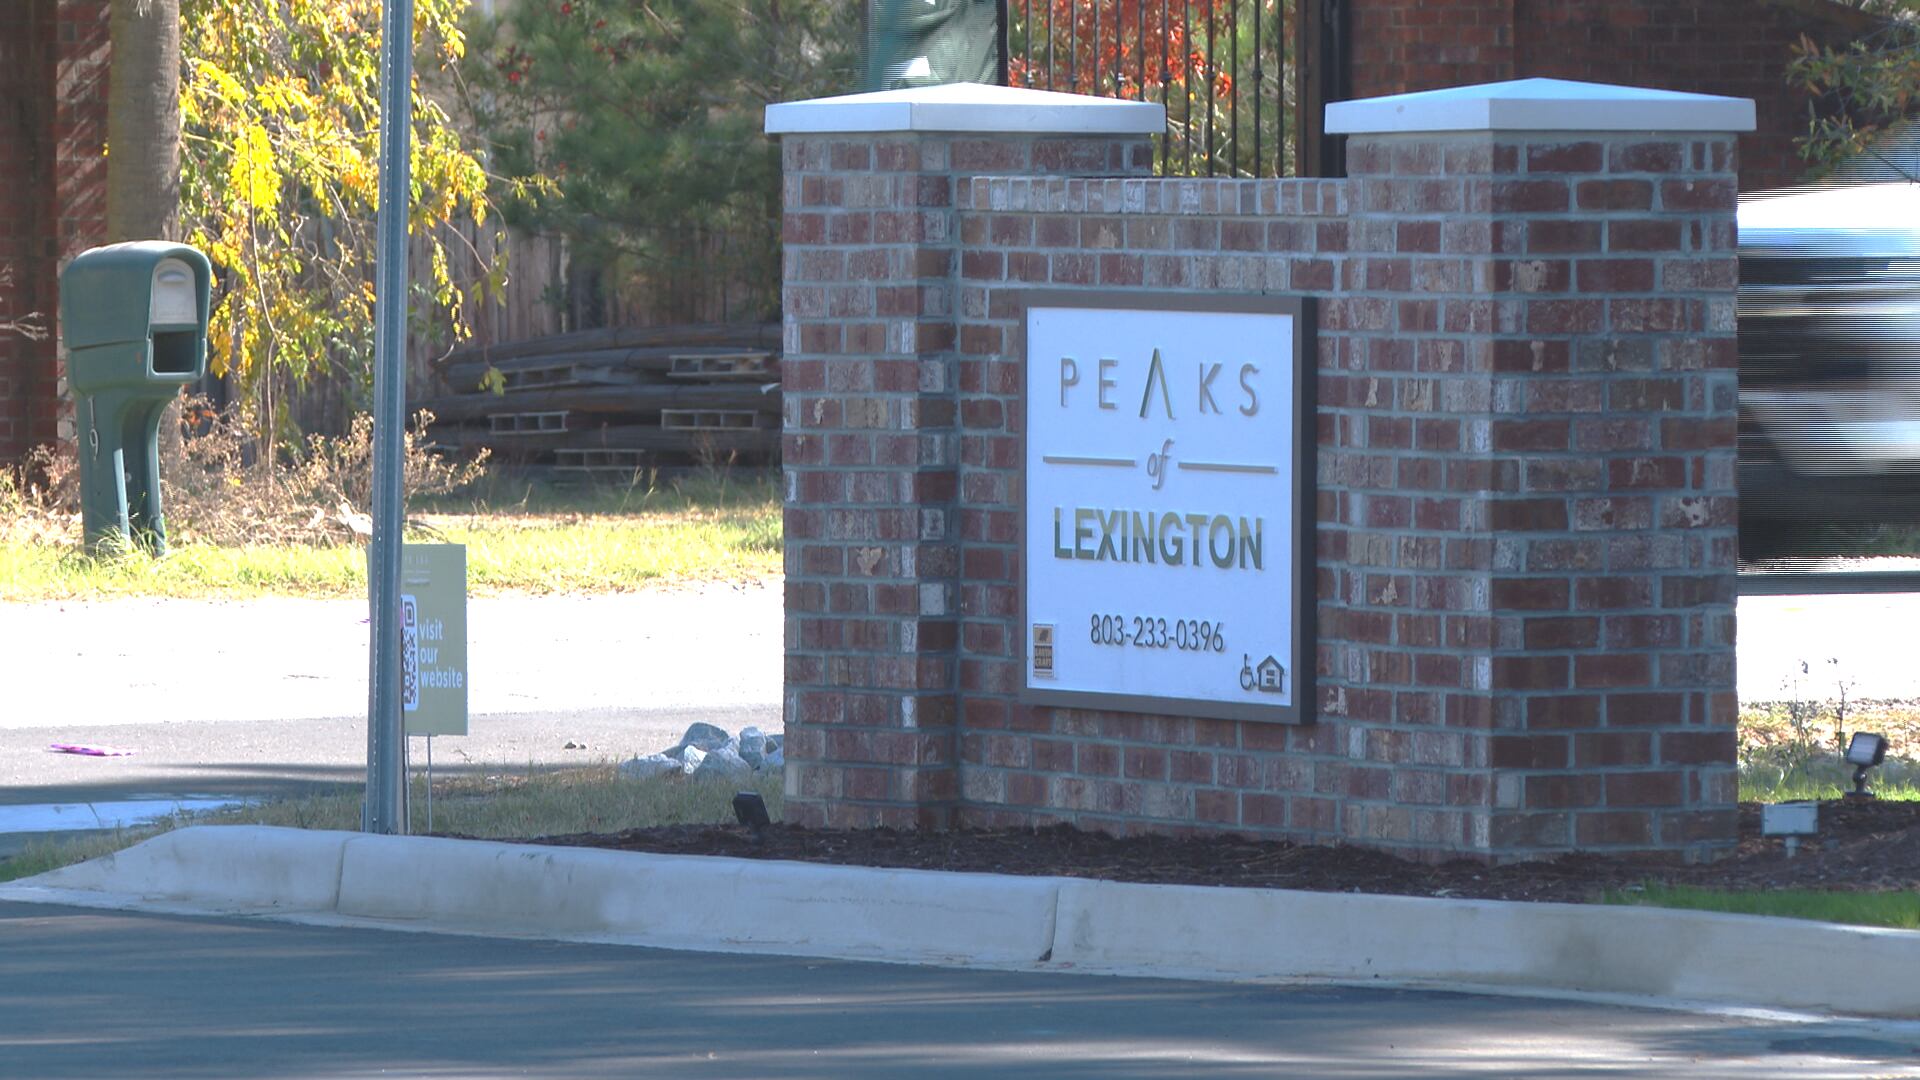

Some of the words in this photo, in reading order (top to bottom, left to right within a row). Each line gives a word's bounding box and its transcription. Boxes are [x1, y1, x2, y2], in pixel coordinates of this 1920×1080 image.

[1060, 347, 1260, 420] PEAKS
[1147, 438, 1174, 490] of
[1053, 506, 1264, 571] LEXINGTON
[419, 618, 443, 641] visit
[1090, 613, 1225, 652] 803-233-0396
[420, 647, 438, 665] our
[420, 667, 463, 688] website
